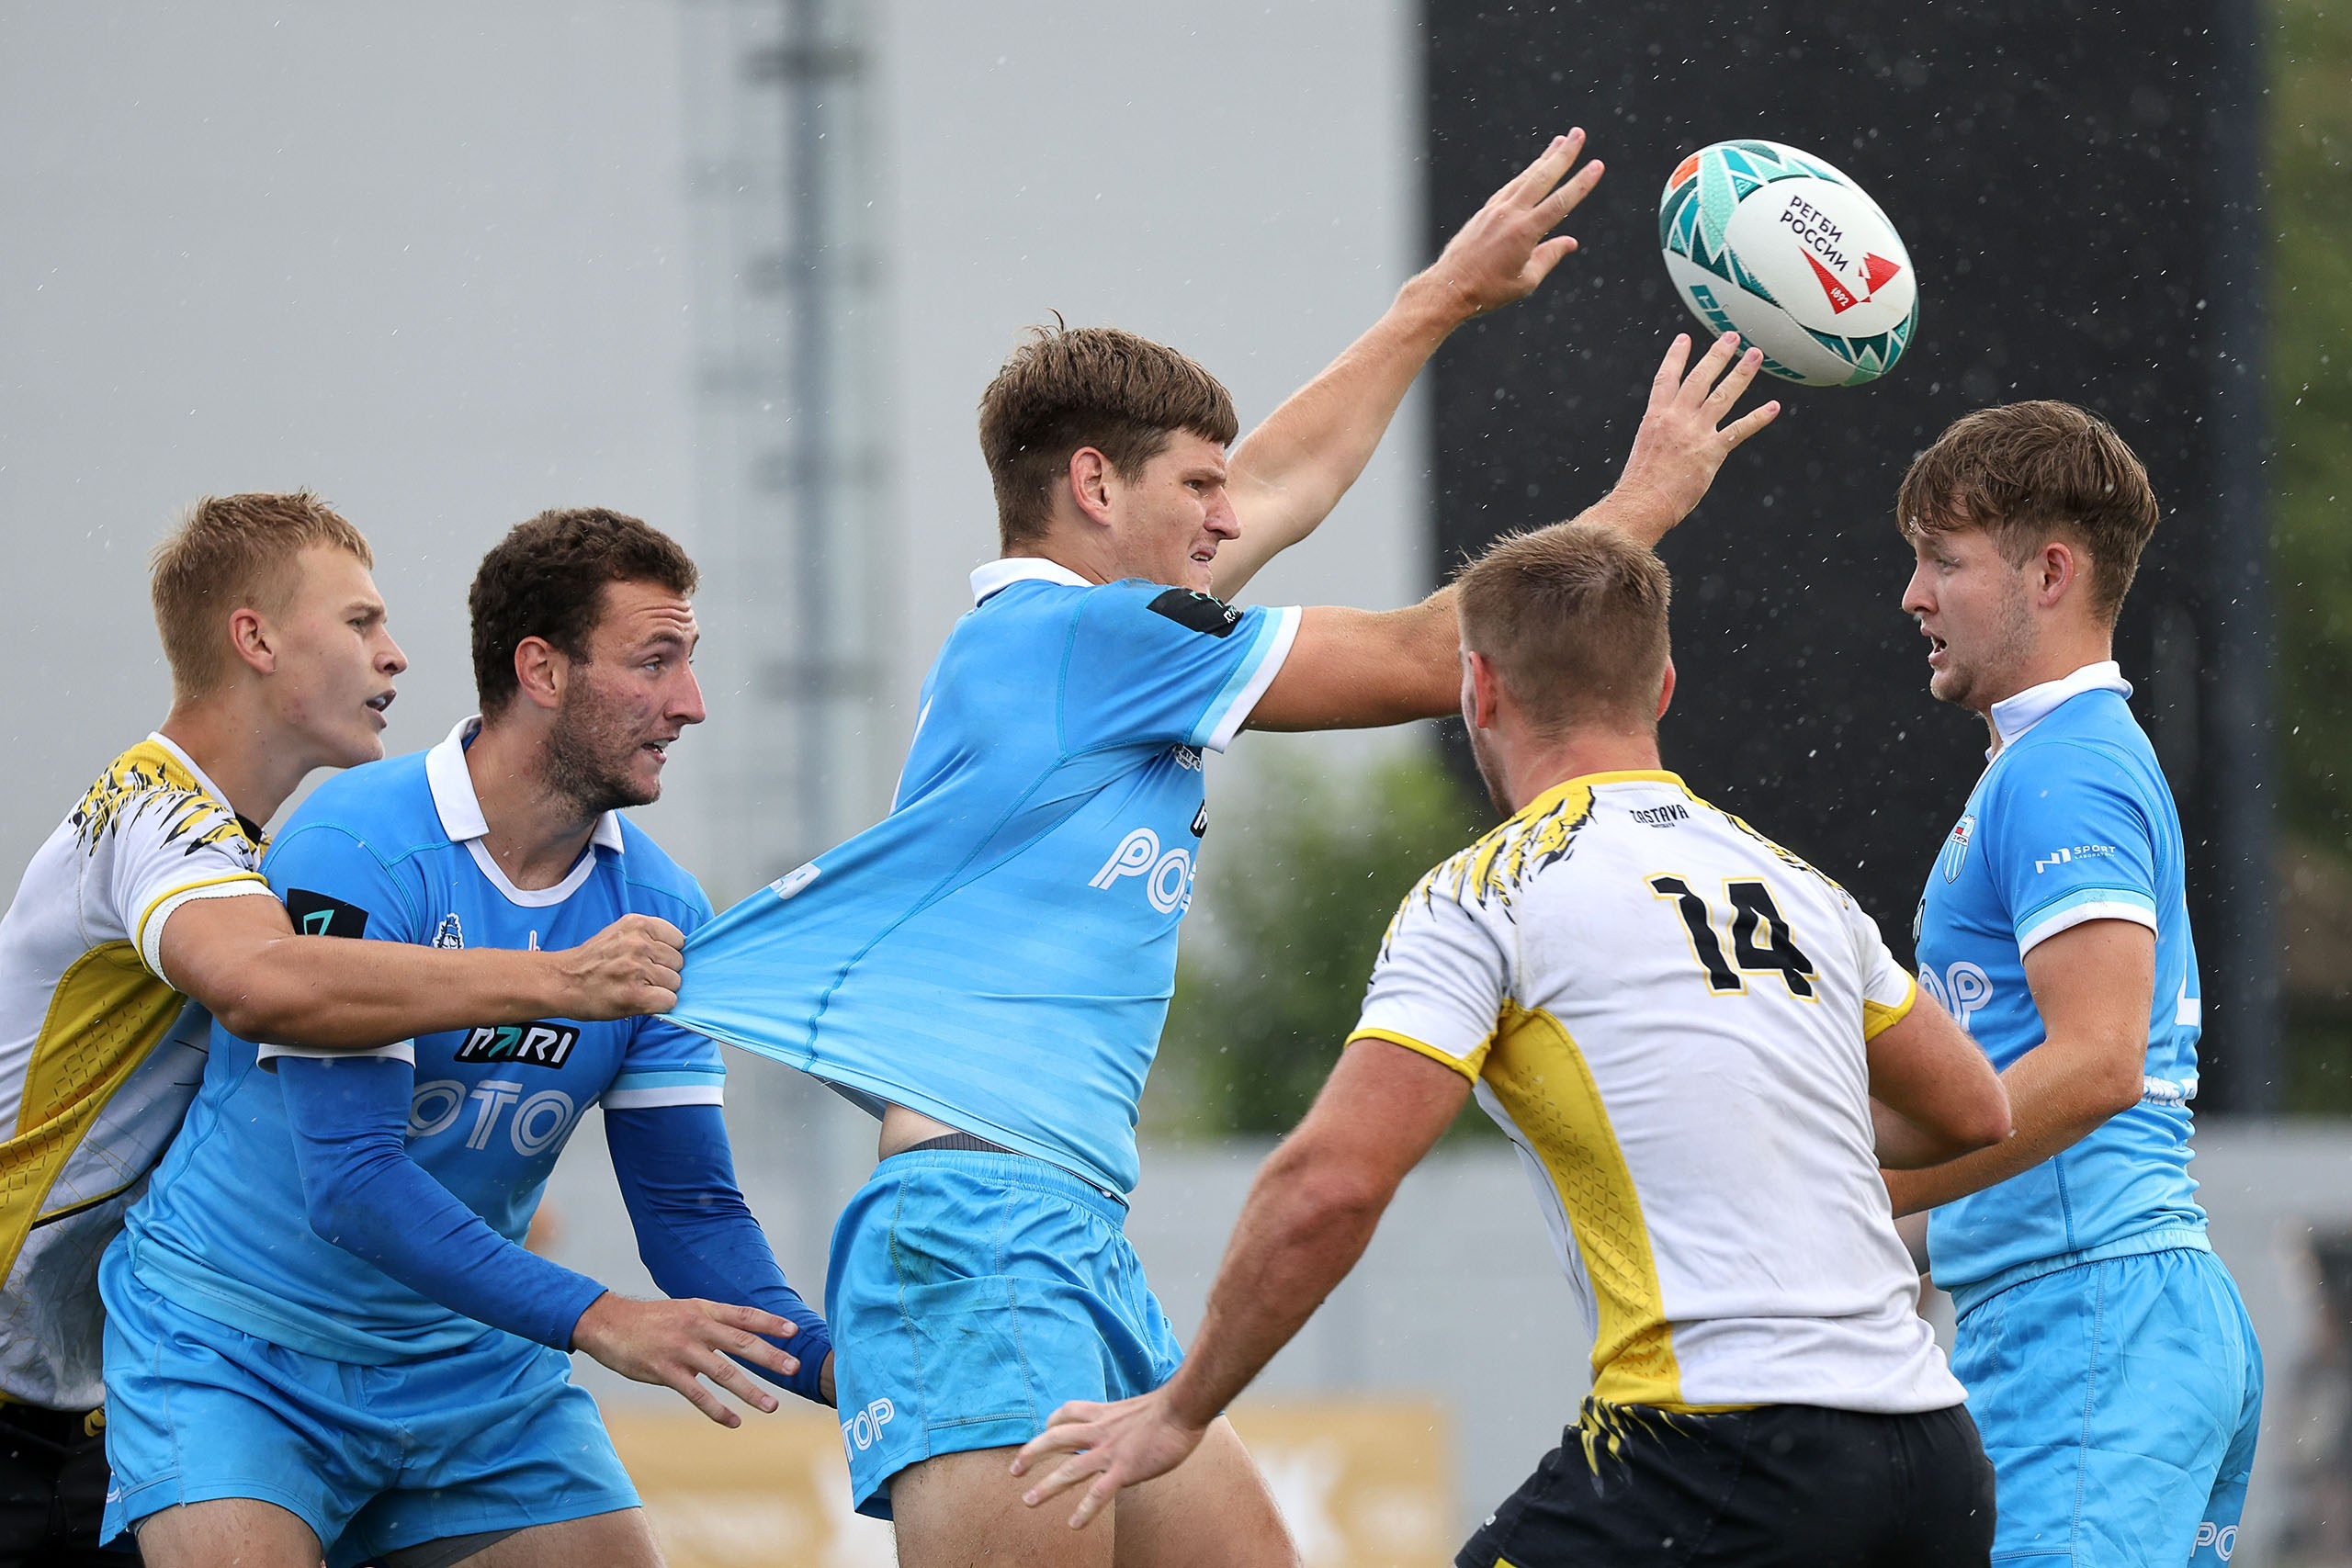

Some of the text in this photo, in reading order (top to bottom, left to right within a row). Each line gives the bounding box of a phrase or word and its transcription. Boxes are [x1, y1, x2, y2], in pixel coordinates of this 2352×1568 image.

[1780, 209, 1849, 272] РОССИИ
[1790, 195, 1842, 243] РЕГБИ
[1830, 287, 1850, 307] 1892
[1629, 804, 1690, 824] ZASTAVA
[1088, 827, 1197, 914] РО
[2074, 844, 2117, 855] SPORT
[1643, 872, 1819, 1003] 14
[461, 1026, 572, 1063] PARI
[405, 1079, 600, 1156] ОТО
